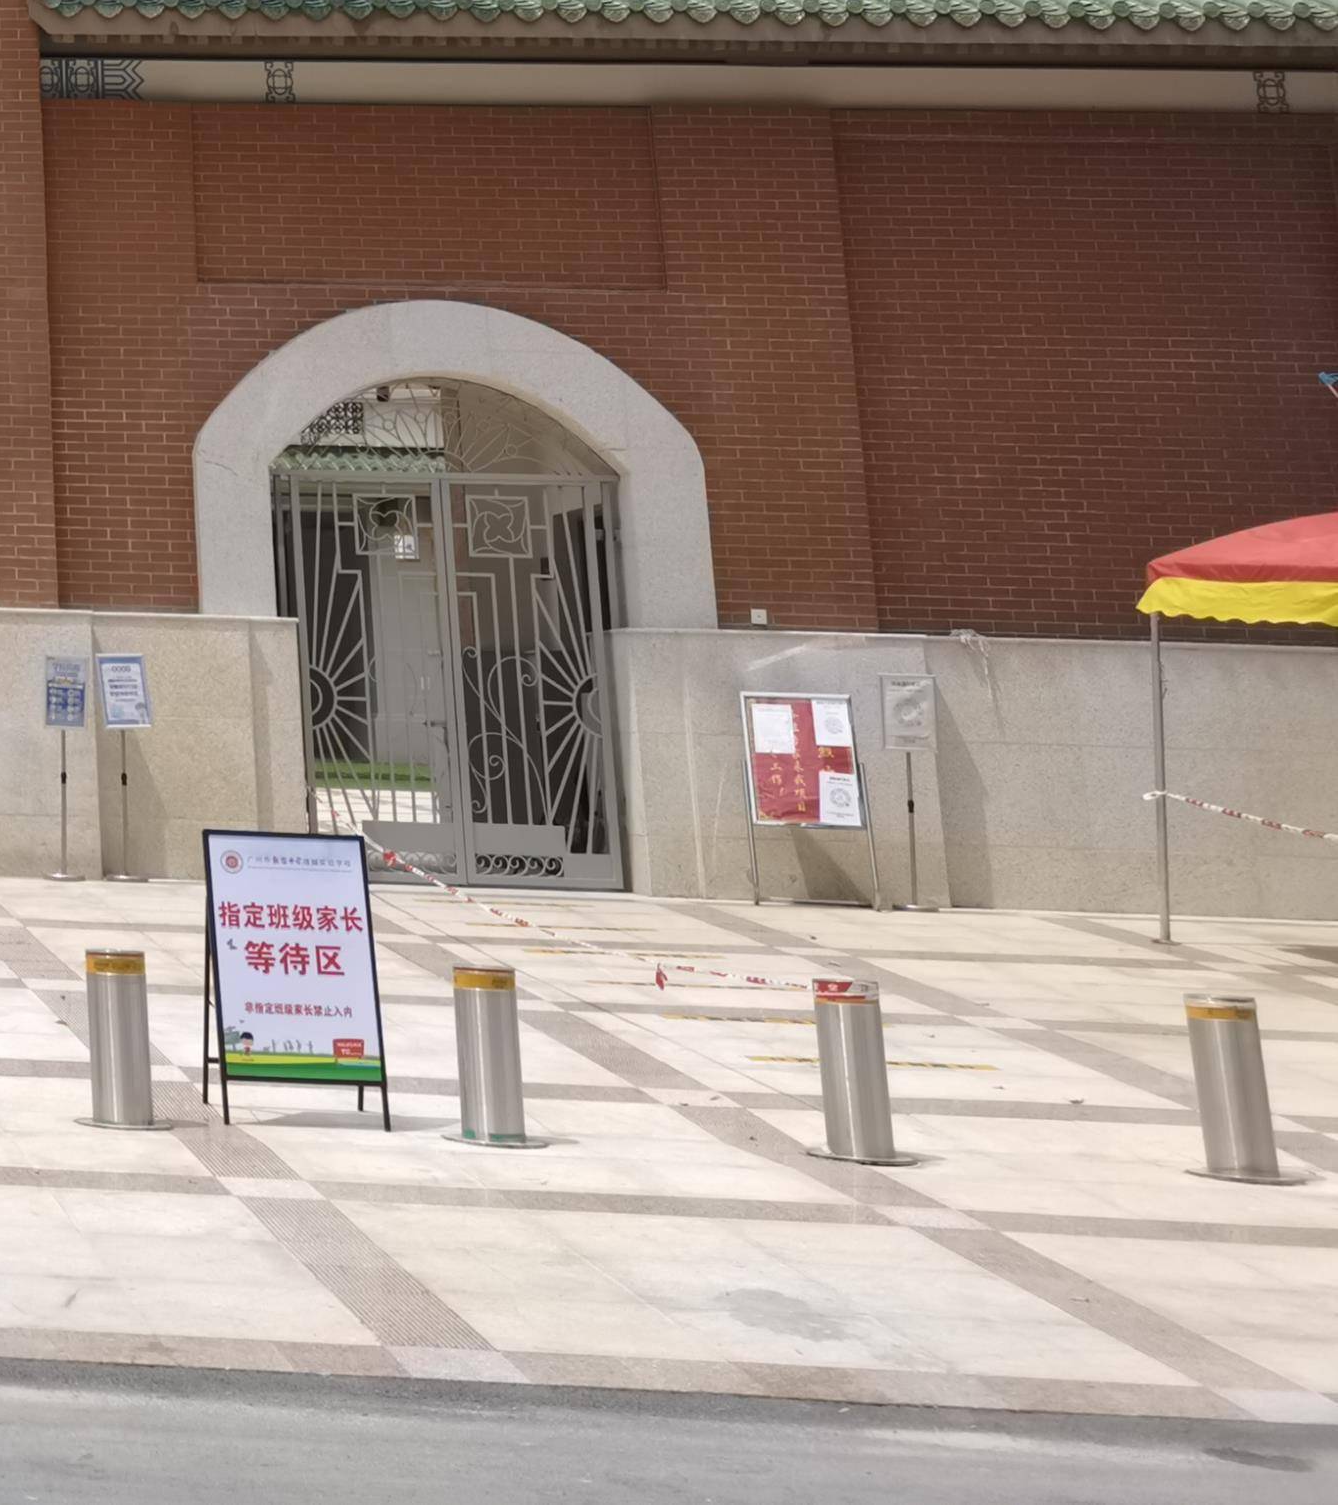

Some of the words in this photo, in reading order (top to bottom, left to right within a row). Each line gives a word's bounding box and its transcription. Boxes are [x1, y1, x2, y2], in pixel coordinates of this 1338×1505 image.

[218, 901, 364, 933] 指定班级家长
[244, 941, 345, 976] 等待区
